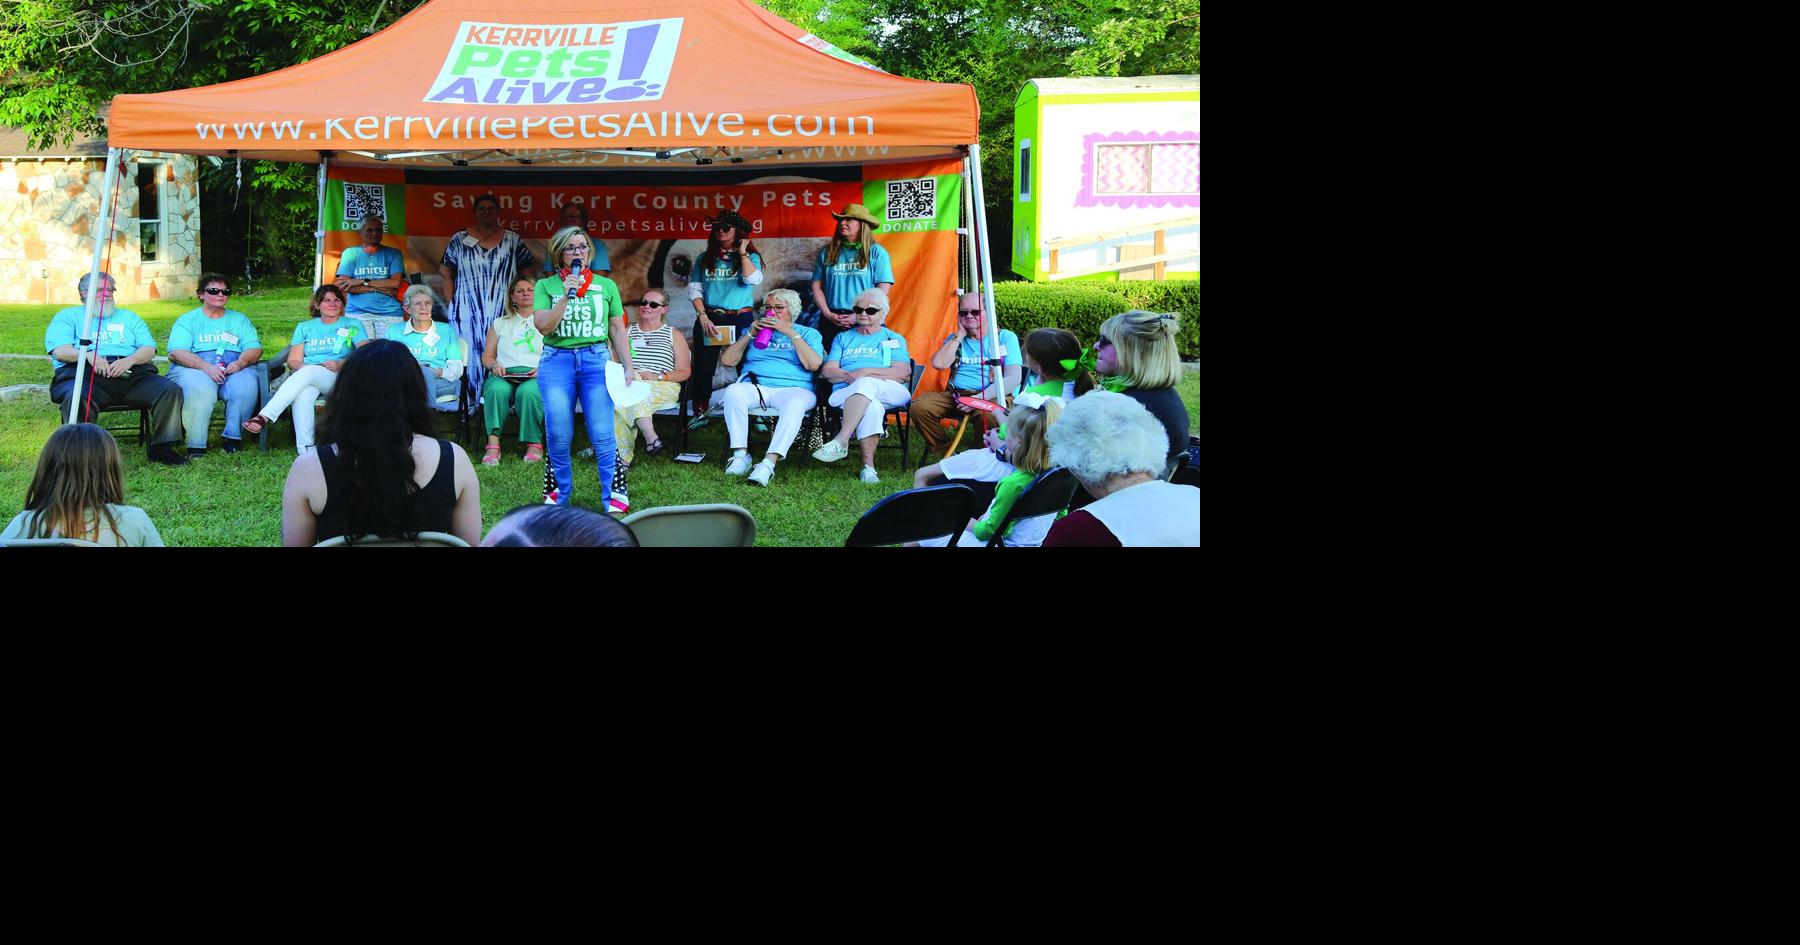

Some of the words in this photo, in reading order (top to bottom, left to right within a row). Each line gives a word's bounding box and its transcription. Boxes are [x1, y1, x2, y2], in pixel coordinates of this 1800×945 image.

[465, 25, 618, 47] KERRVILLE
[450, 45, 611, 78] Pets
[433, 190, 533, 213] Sang
[633, 192, 744, 212] County
[762, 189, 832, 208] Pets
[341, 221, 389, 233] DOE
[882, 221, 938, 232] DONATE
[354, 266, 388, 276] unity
[552, 303, 592, 321] ets
